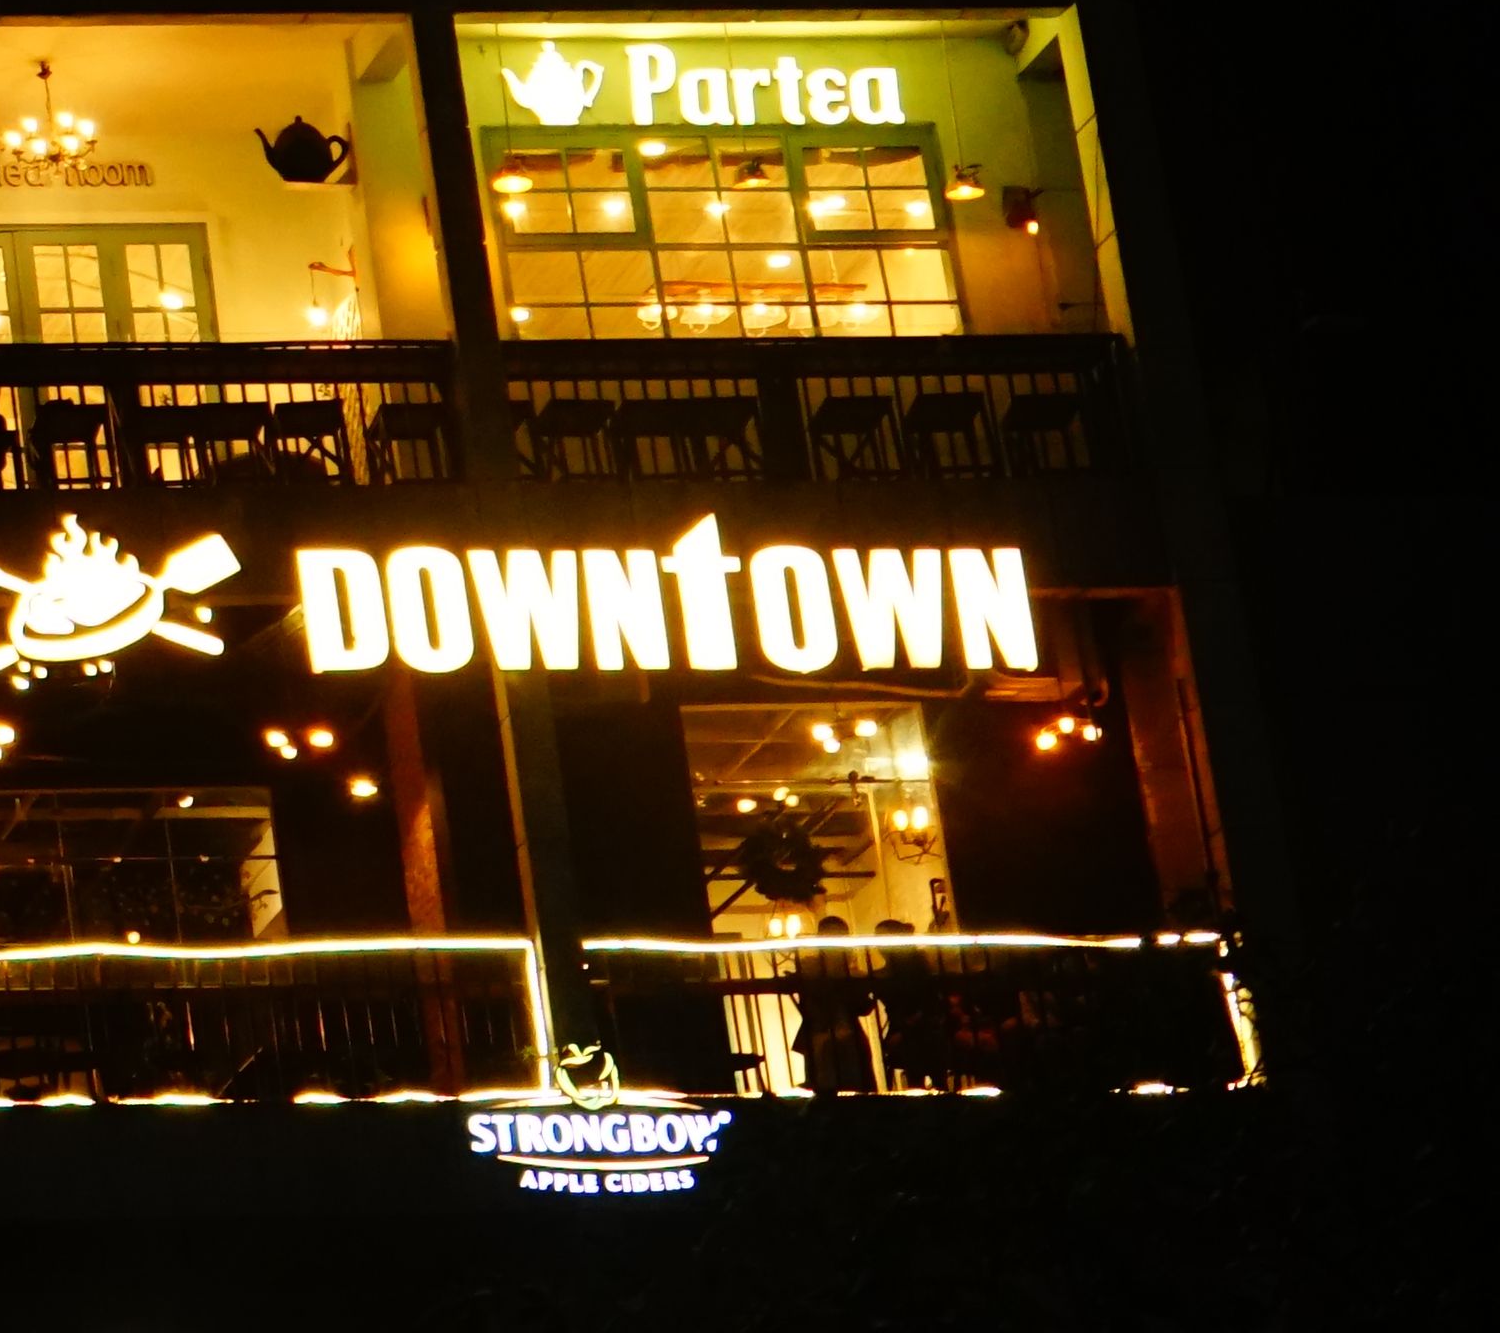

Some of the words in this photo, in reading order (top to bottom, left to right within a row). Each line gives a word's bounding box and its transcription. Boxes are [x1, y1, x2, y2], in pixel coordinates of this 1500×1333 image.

[626, 42, 906, 127] Partea
[467, 1111, 732, 1154] STRONGBOW
[519, 1169, 600, 1194] APPLE
[604, 1169, 696, 1194] CIDERS
